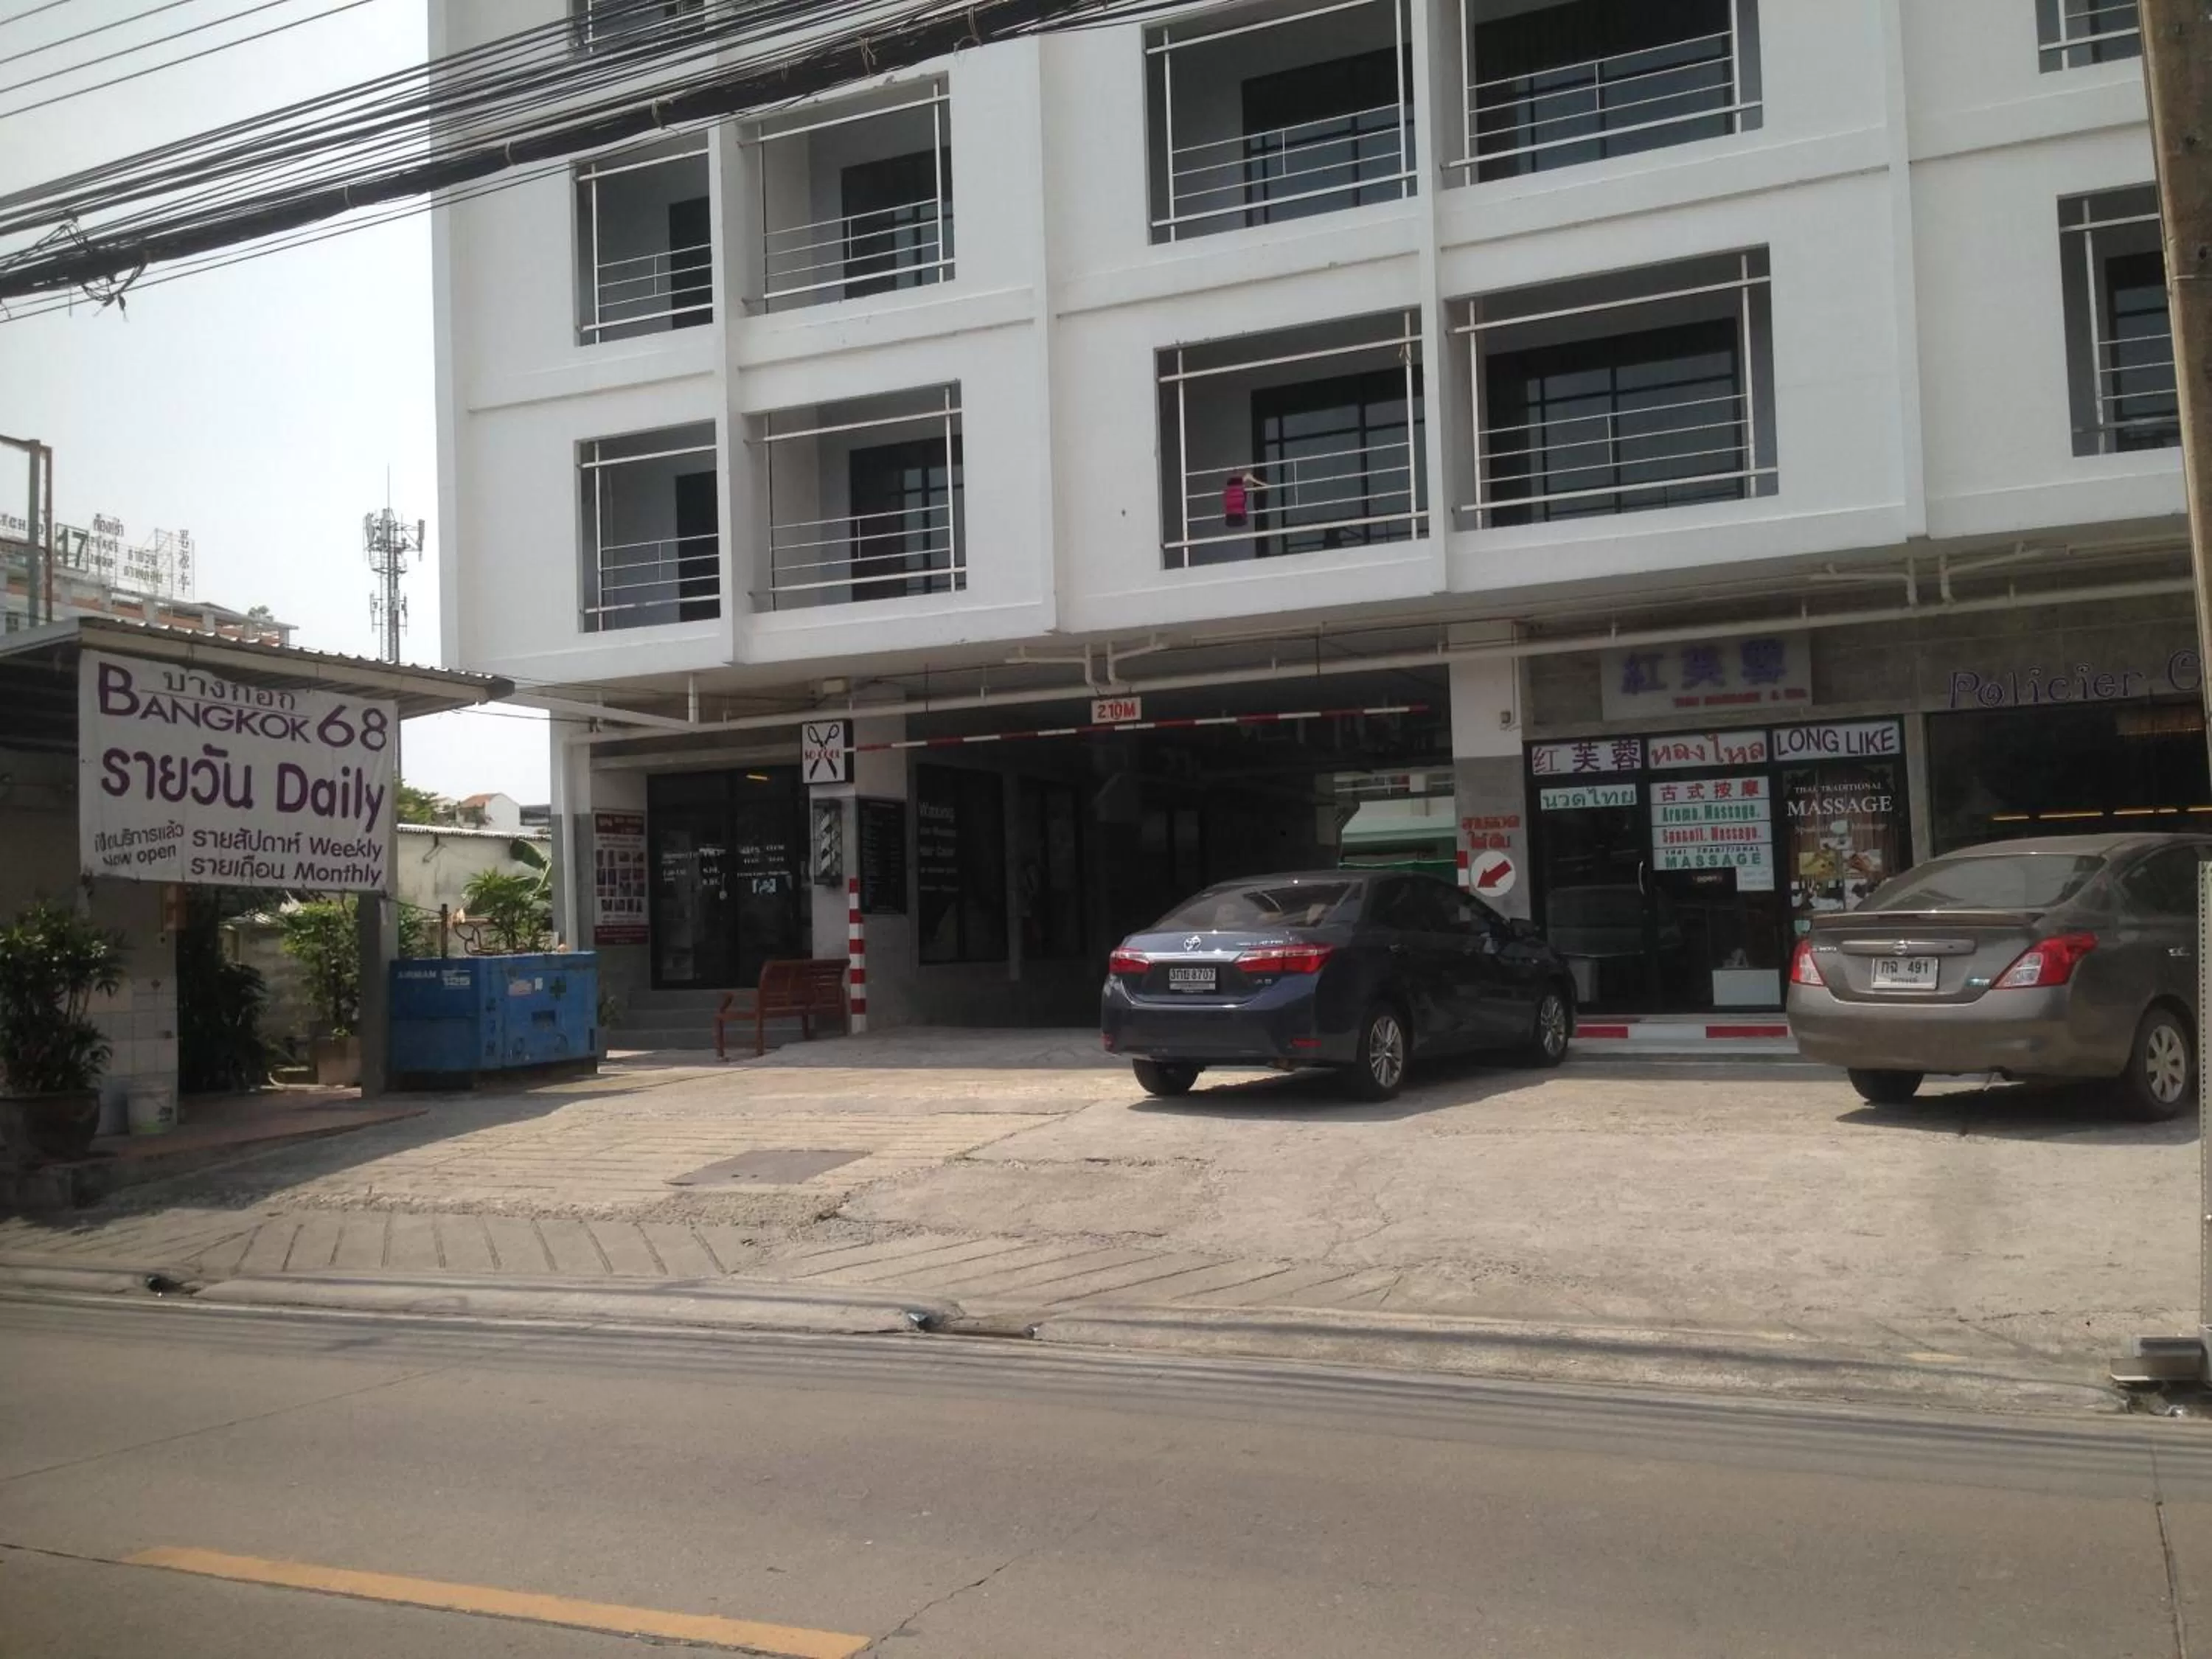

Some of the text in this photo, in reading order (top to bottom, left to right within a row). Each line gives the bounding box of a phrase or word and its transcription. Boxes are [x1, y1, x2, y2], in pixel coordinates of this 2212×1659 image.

[58, 526, 88, 568] 17
[1949, 662, 2146, 709] Policier
[97, 661, 389, 751] BANGKOK 68
[1777, 726, 1896, 756] LONG LIKE
[1534, 740, 1640, 773] 红芙蓉
[100, 742, 385, 833] รายวัน Daily
[1542, 787, 1635, 809] นวดไทย
[1660, 779, 1759, 801] 古式按摩
[1787, 795, 1893, 816] MASSAGE
[136, 844, 184, 866] open
[192, 827, 382, 862] รายสัปดาห์ Weekly
[190, 855, 382, 886] รายเดือน Monthly
[1665, 853, 1761, 868] MASSAGE
[1907, 960, 1929, 974] 491
